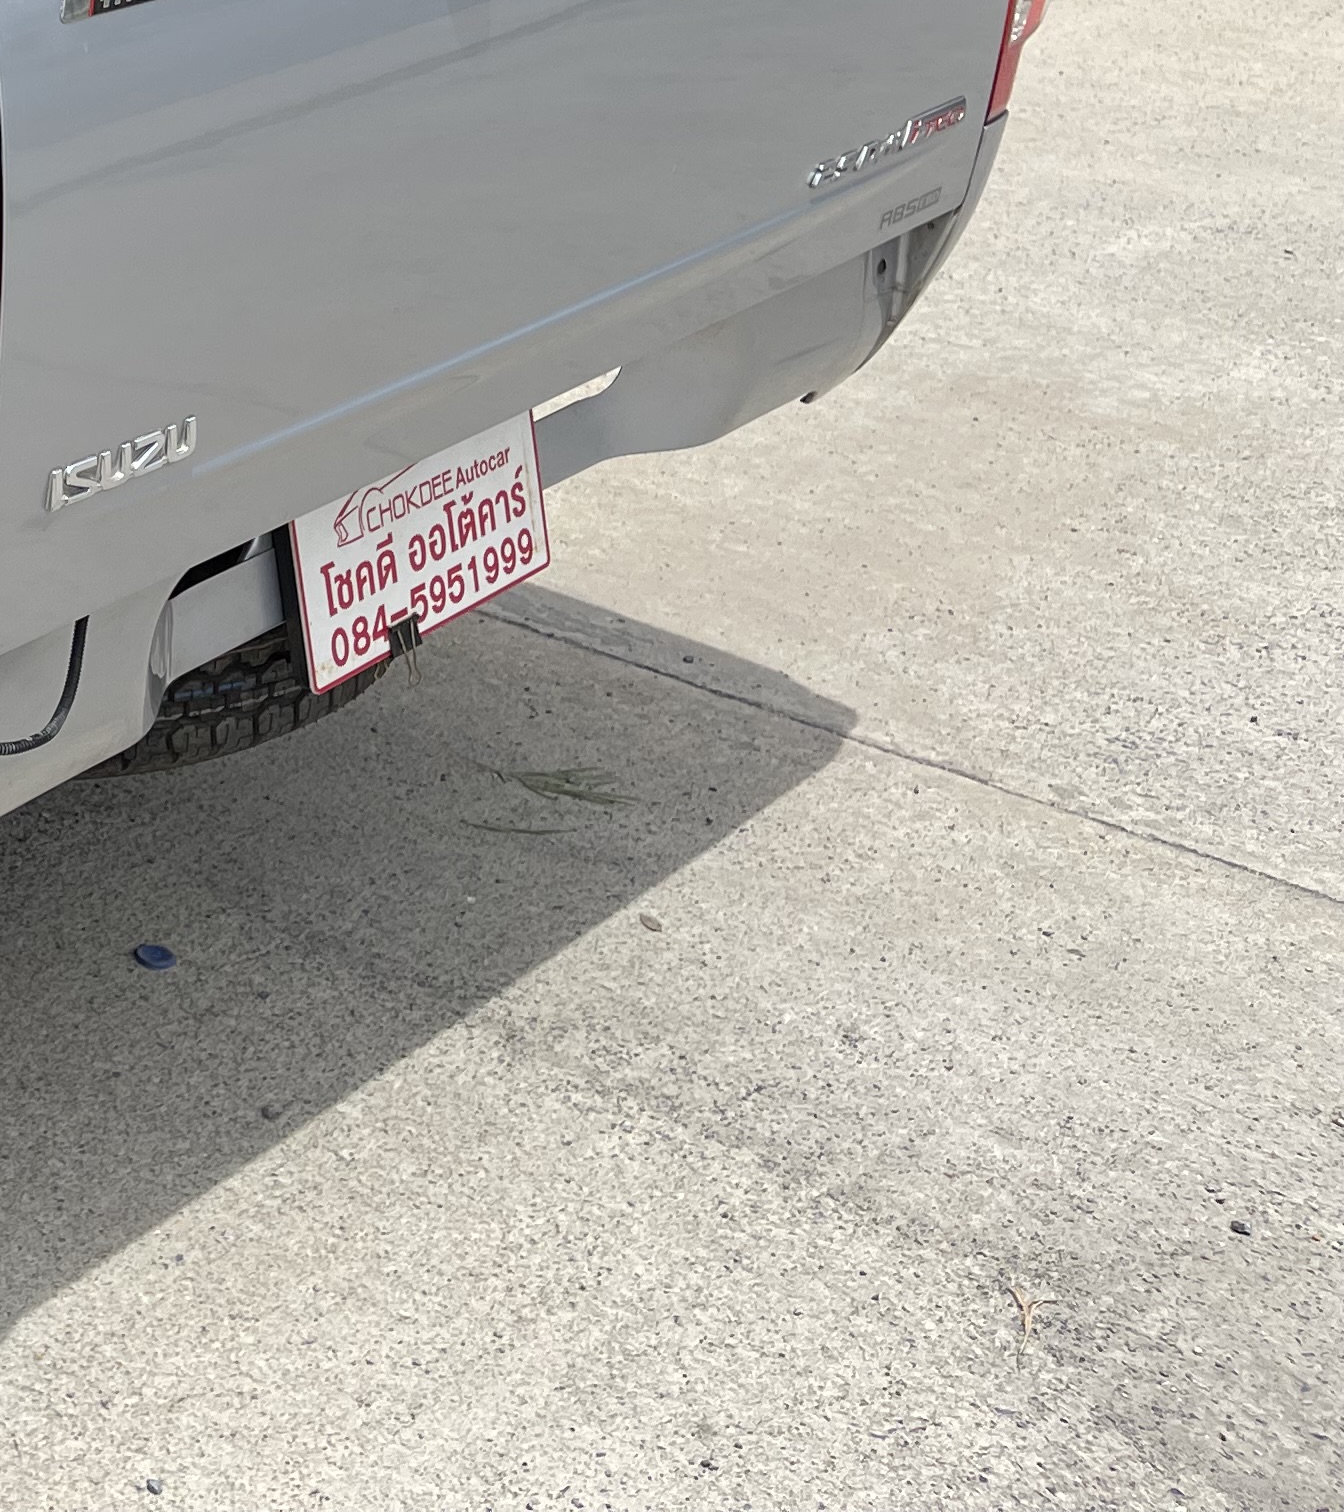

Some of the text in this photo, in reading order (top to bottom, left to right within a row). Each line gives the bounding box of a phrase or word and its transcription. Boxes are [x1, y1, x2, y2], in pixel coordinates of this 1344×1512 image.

[44, 414, 198, 513] ISUZU
[365, 446, 511, 534] CHOKDEE Autocar
[319, 464, 527, 618] โชคดี ออโต้คาร์
[330, 527, 534, 668] 084-5951999
